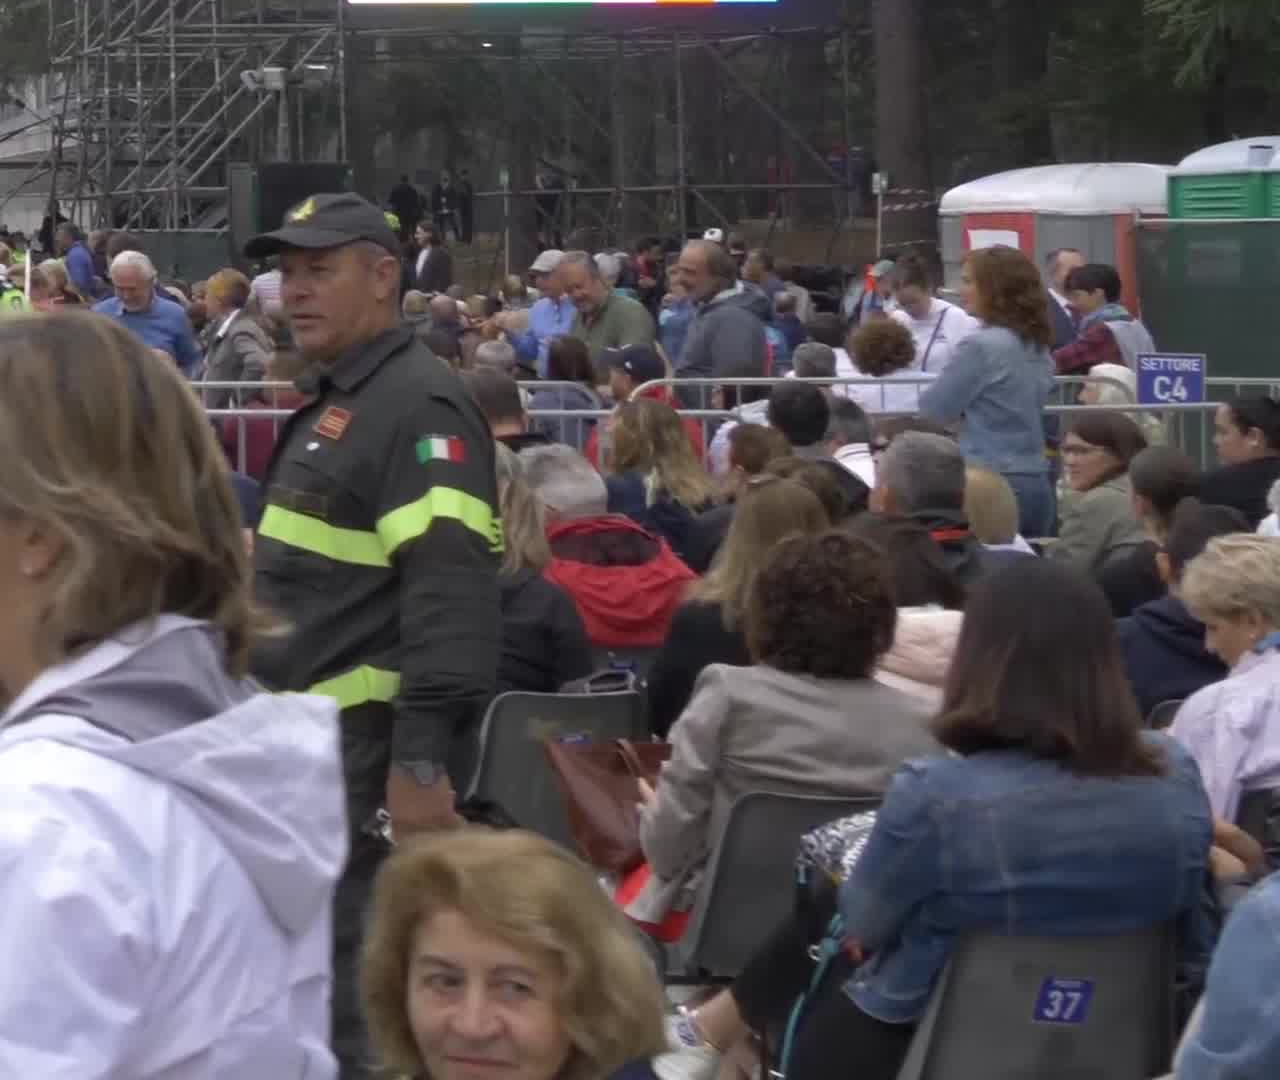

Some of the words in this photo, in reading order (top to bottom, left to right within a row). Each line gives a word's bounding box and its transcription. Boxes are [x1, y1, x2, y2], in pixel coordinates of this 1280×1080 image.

[1140, 357, 1201, 372] SETTORE
[1153, 375, 1188, 401] C4
[1041, 990, 1083, 1020] 37
